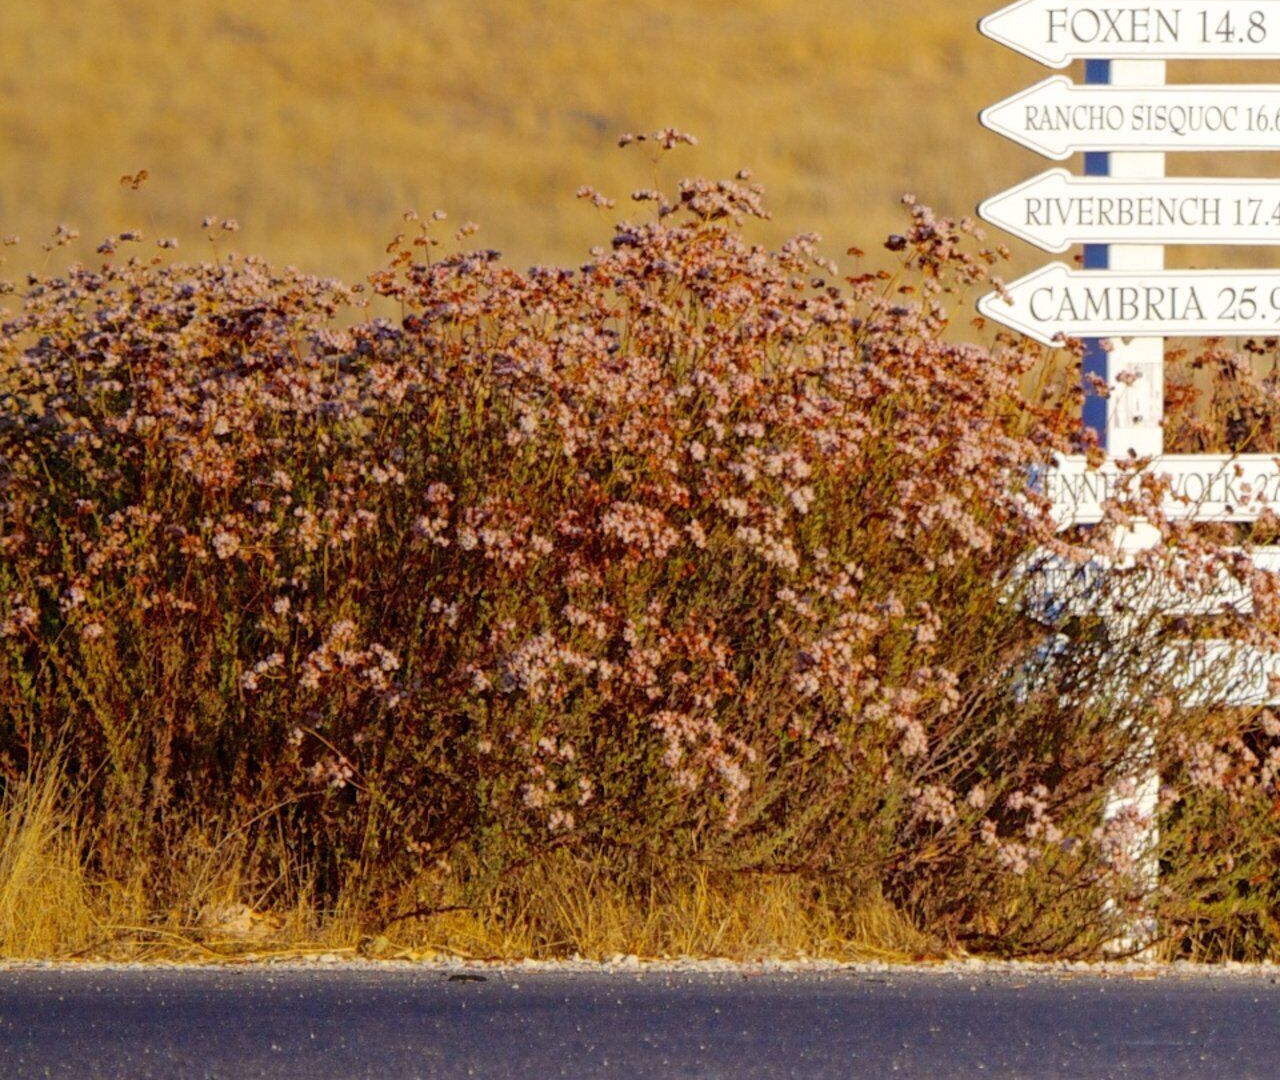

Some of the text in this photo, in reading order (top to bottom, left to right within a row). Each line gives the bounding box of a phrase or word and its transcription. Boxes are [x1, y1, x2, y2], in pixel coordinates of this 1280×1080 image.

[1046, 8, 1266, 44] FOXEN 14.8
[1024, 105, 1124, 131] RANCHO
[1132, 105, 1238, 136] SISQUOC
[1024, 197, 1222, 226] RIVERBENCH
[1029, 285, 1208, 322] CAMBRIA
